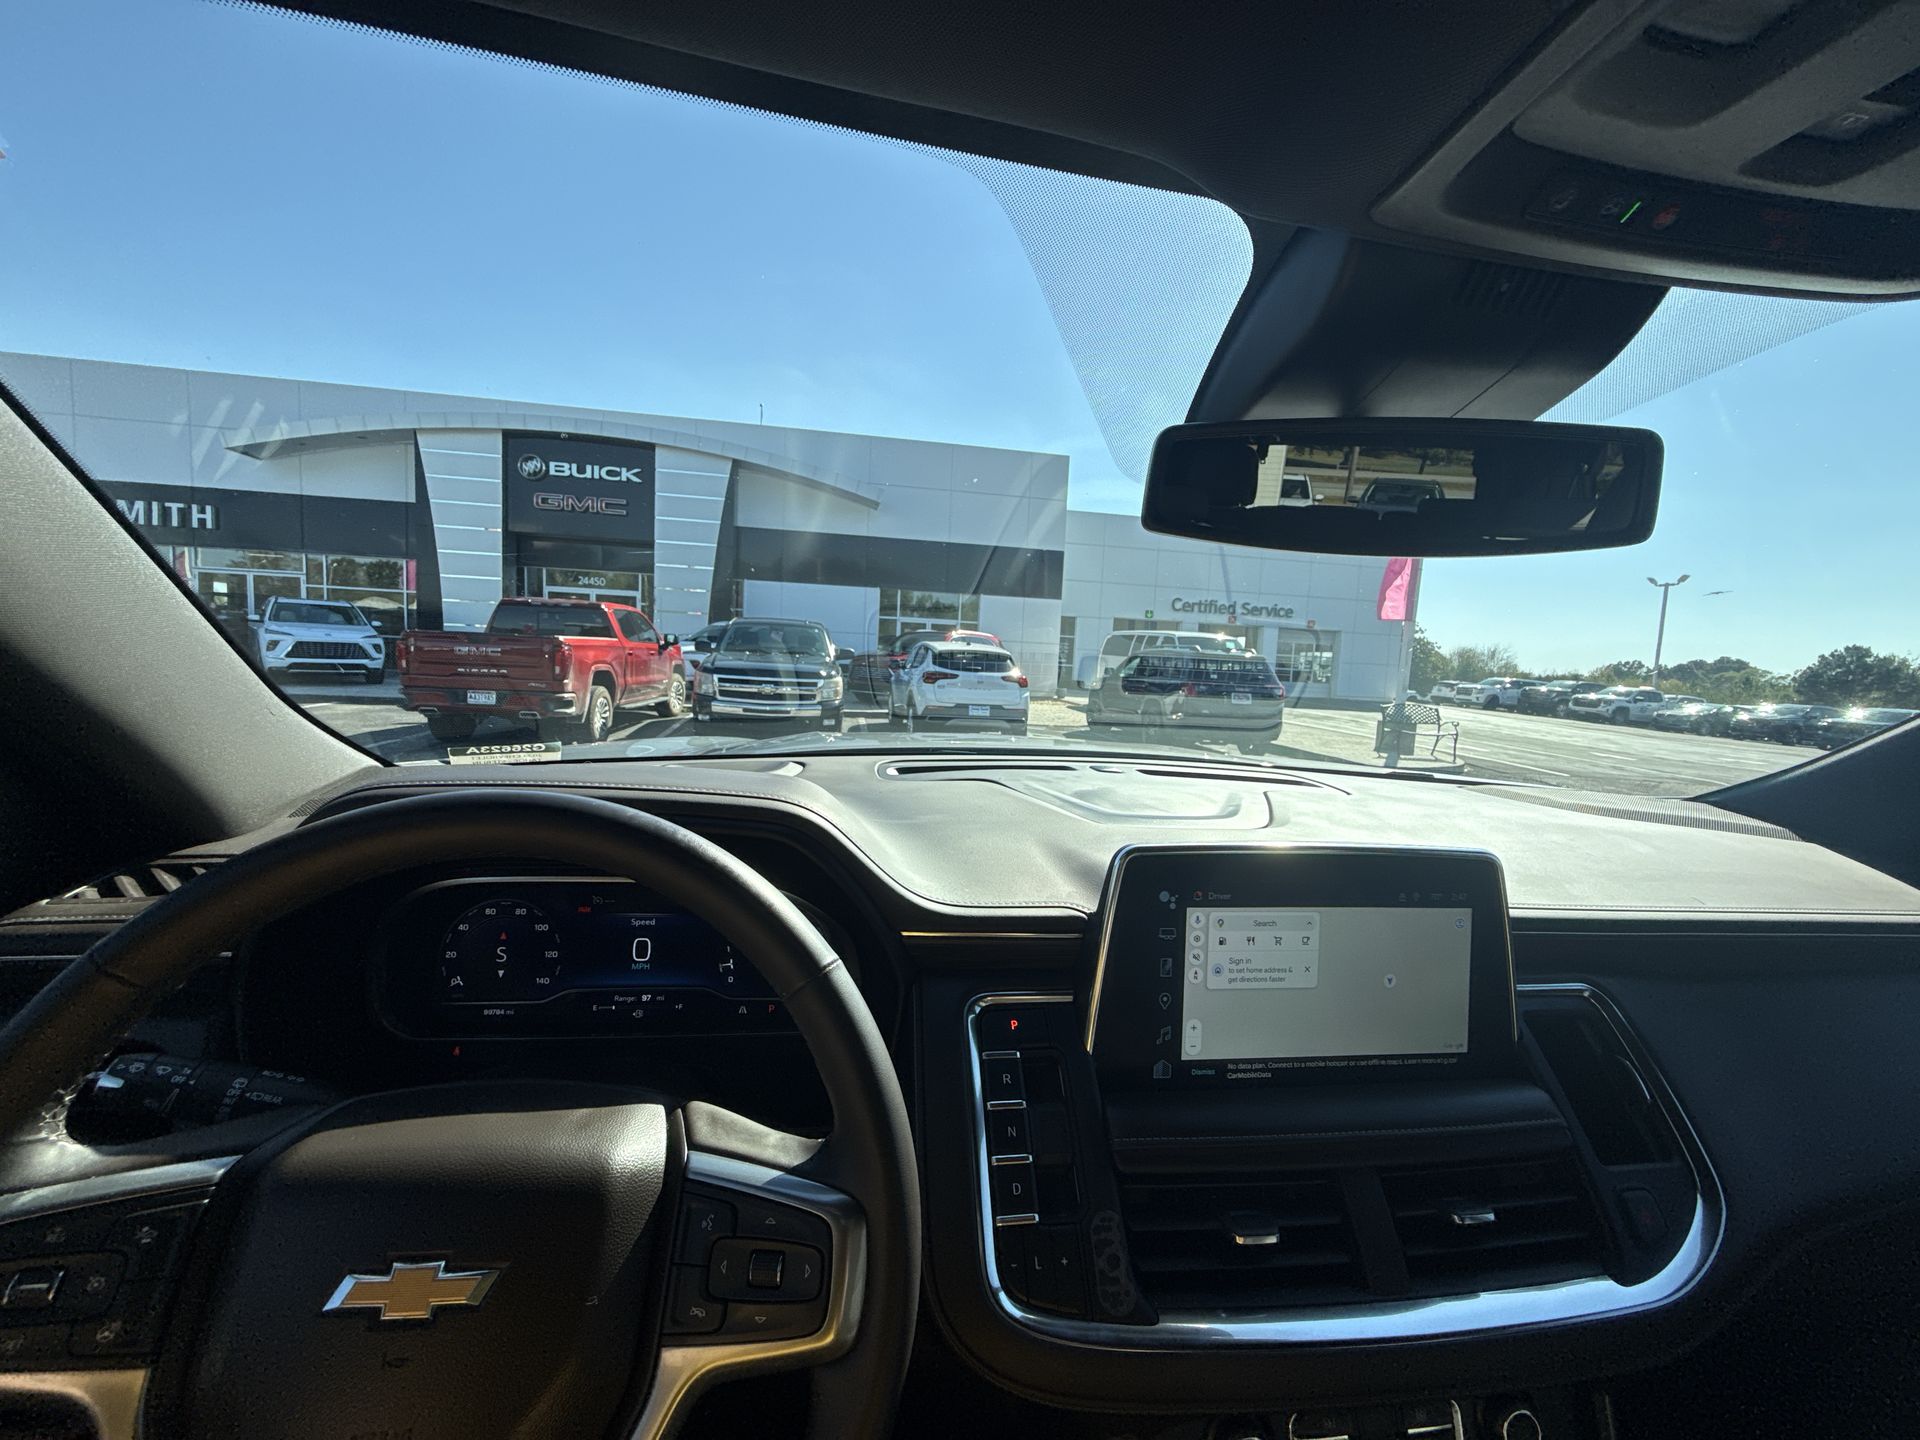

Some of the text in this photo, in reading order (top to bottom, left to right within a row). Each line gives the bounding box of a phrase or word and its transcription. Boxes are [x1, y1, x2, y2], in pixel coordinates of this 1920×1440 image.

[548, 461, 643, 483] BUICK
[534, 492, 627, 515] GMC
[577, 576, 606, 587] 24450
[1171, 597, 1294, 619] Certified Service
[454, 646, 502, 656] GMC
[1208, 892, 1232, 900] Driver
[631, 918, 655, 927] Speed
[496, 947, 507, 962] S
[632, 938, 651, 962] 0
[631, 963, 650, 971] MPH
[1228, 957, 1244, 966] Sign
[1228, 976, 1239, 984] get
[614, 995, 637, 1003] Range:
[1010, 1019, 1018, 1030] P
[1252, 1062, 1267, 1070] plan.
[1191, 1068, 1216, 1076] Dismiss
[1002, 1073, 1012, 1084] R
[1007, 1126, 1017, 1137] N
[1012, 1183, 1022, 1196] D
[1034, 1256, 1042, 1270] L
